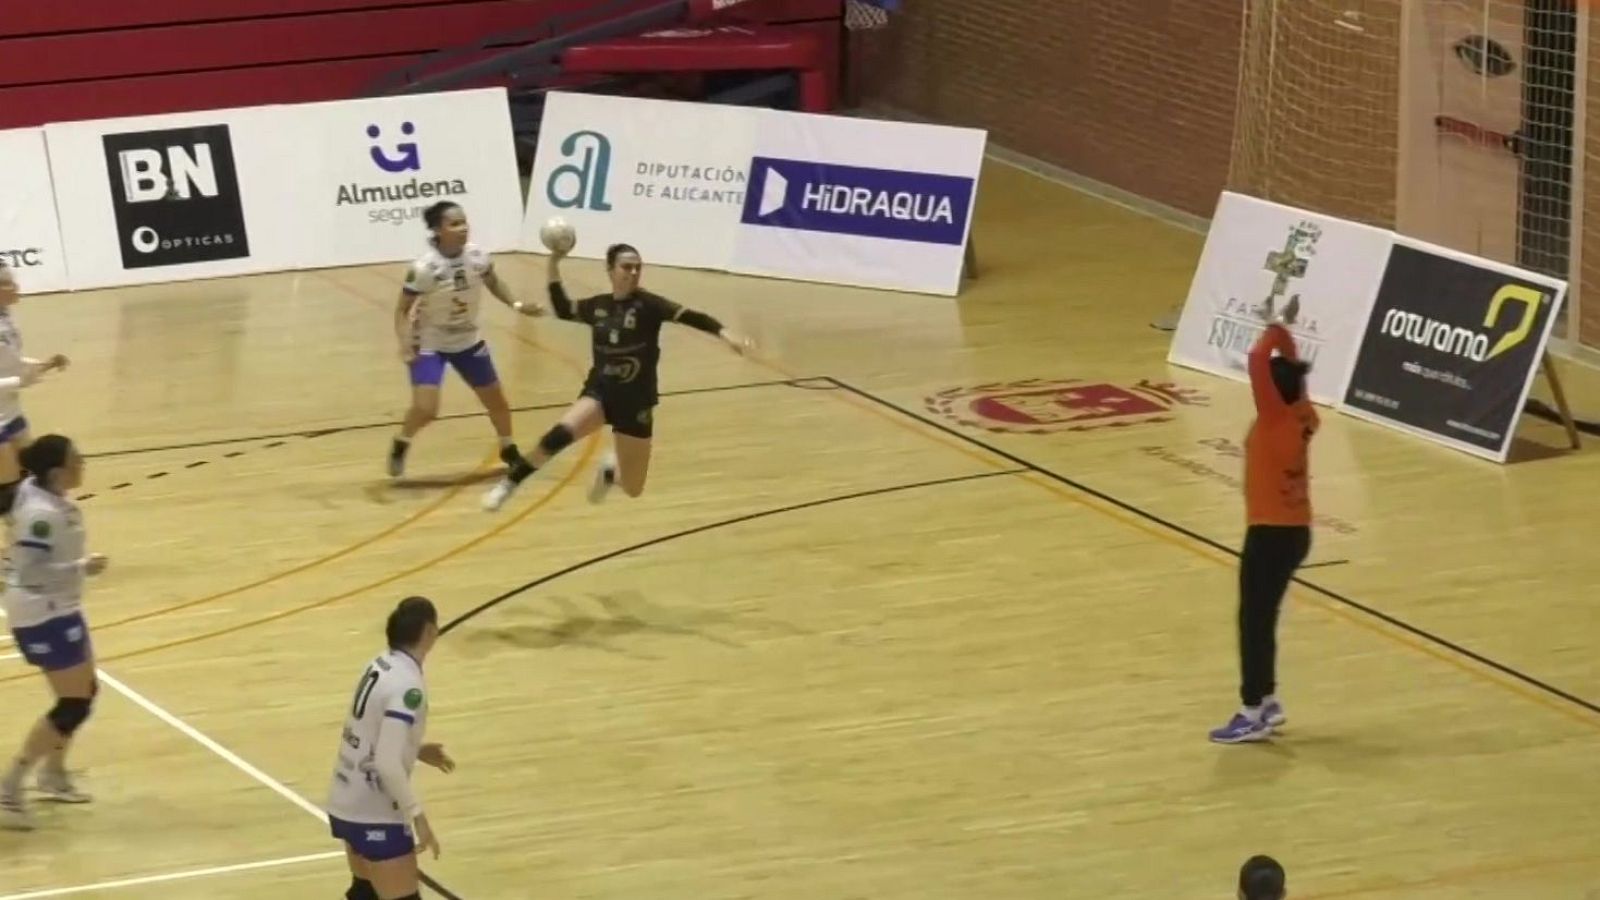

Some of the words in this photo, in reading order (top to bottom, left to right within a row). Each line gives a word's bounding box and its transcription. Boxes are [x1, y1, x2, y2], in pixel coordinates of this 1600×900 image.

[119, 143, 219, 203] BN
[335, 178, 467, 206] Almudena
[633, 182, 654, 198] DE
[660, 186, 744, 205] ALICANTE
[368, 205, 425, 225] segur
[624, 307, 637, 329] 6
[1381, 309, 1489, 362] roturama
